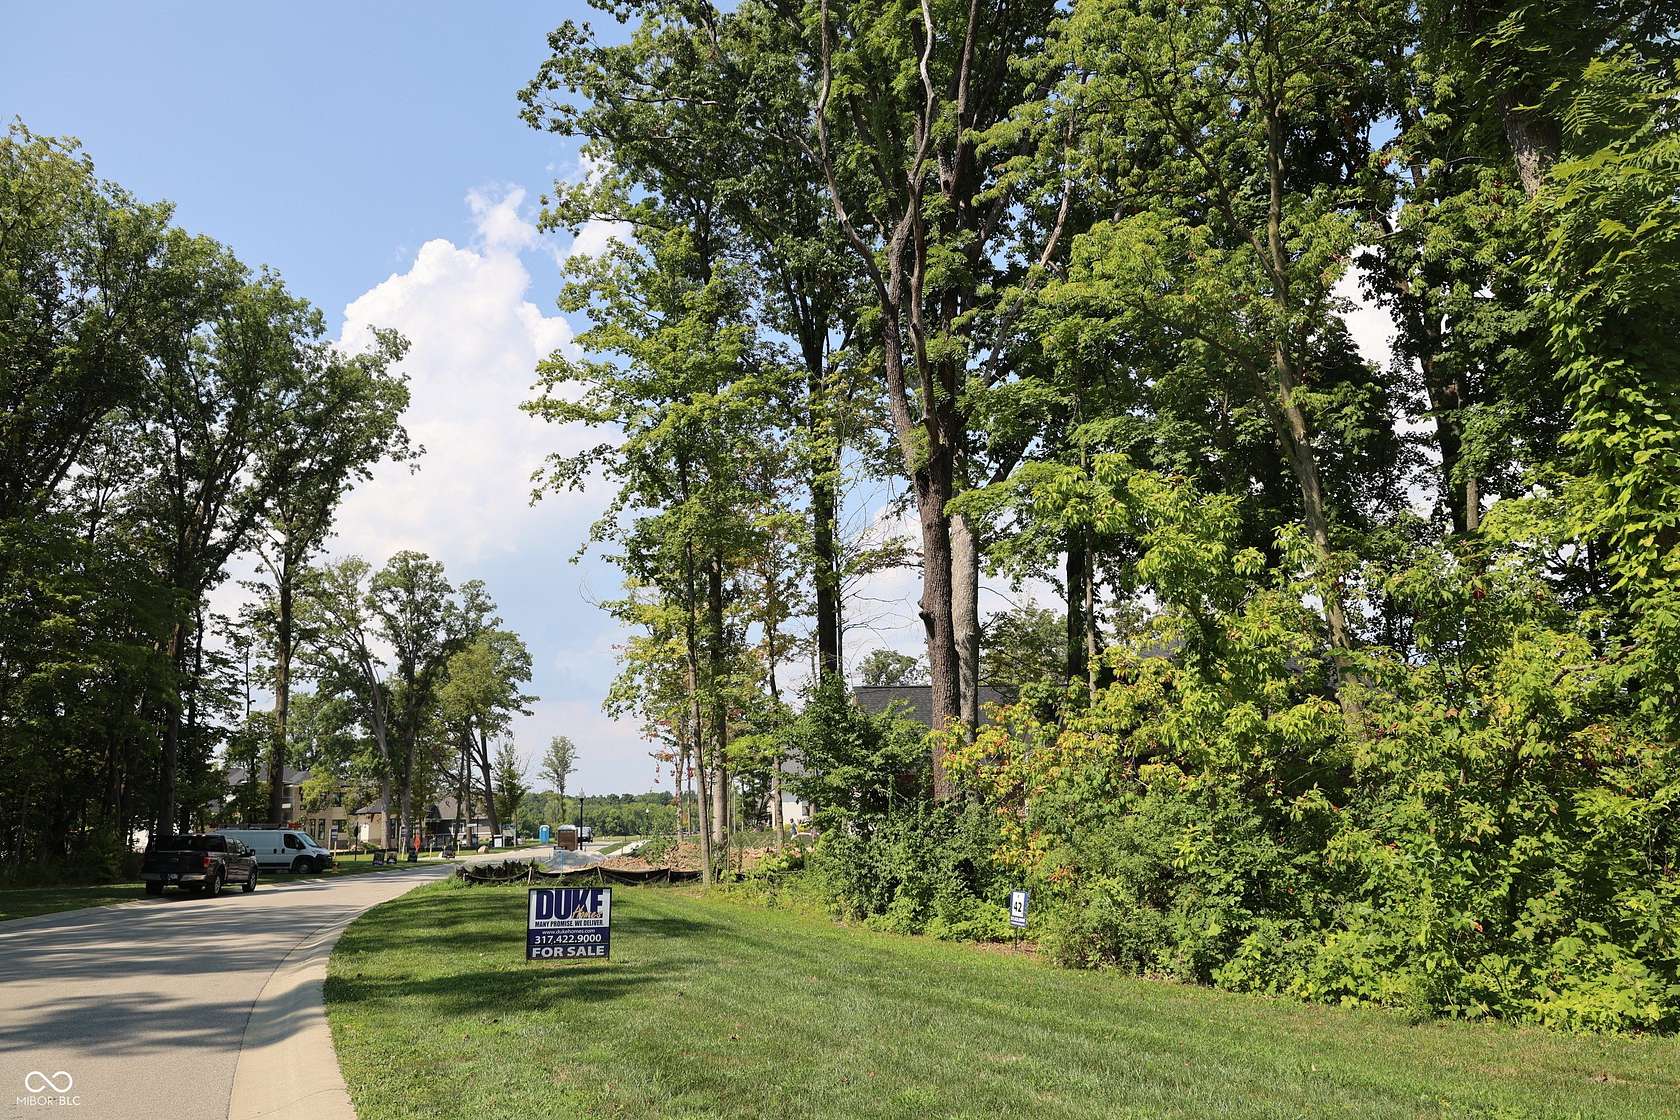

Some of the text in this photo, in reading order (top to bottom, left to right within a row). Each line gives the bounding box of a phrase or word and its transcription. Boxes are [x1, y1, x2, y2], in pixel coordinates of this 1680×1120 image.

[535, 889, 604, 920] DUKE
[1014, 902, 1022, 912] 42
[534, 934, 602, 944] 317.422.9000
[532, 946, 605, 957] FOR SALE
